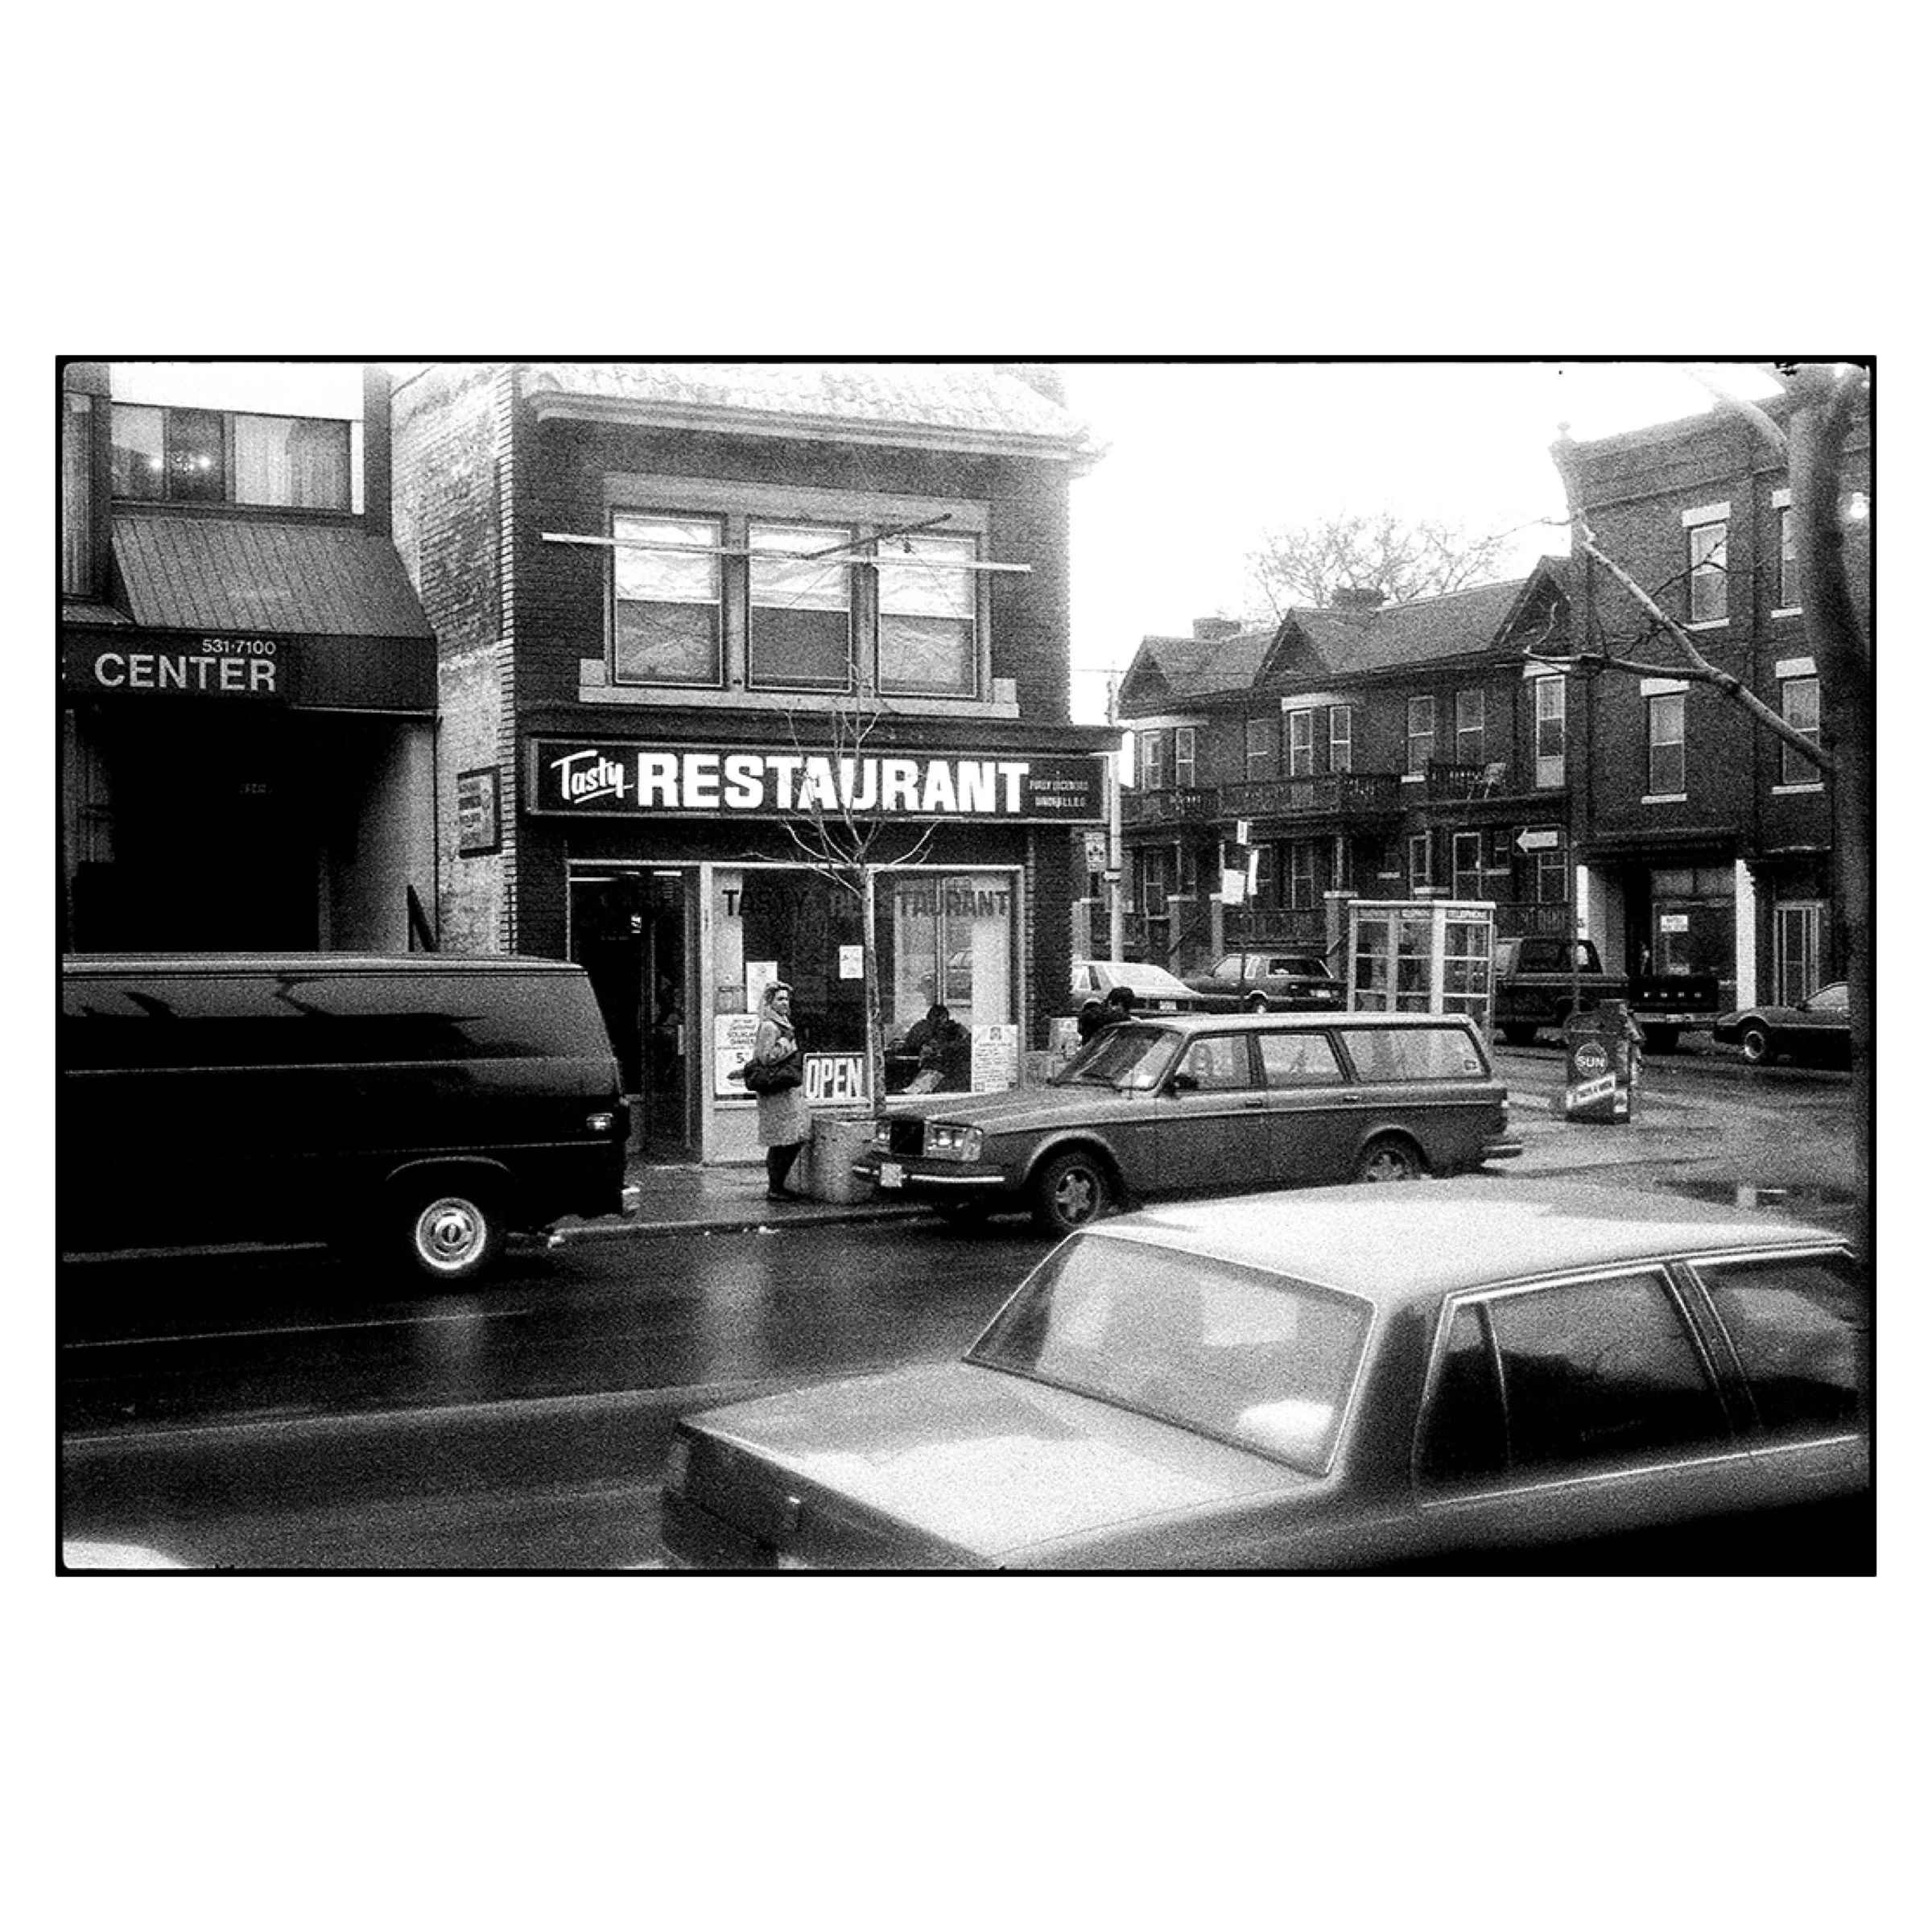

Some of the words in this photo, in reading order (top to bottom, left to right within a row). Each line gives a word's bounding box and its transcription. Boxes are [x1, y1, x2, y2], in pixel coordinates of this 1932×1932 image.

[94, 653, 276, 691] CENTER
[551, 749, 634, 804] Tasty
[638, 753, 1031, 813] RESTAURANT
[806, 1058, 864, 1100] OPEN
[1575, 1055, 1606, 1068] SUN
